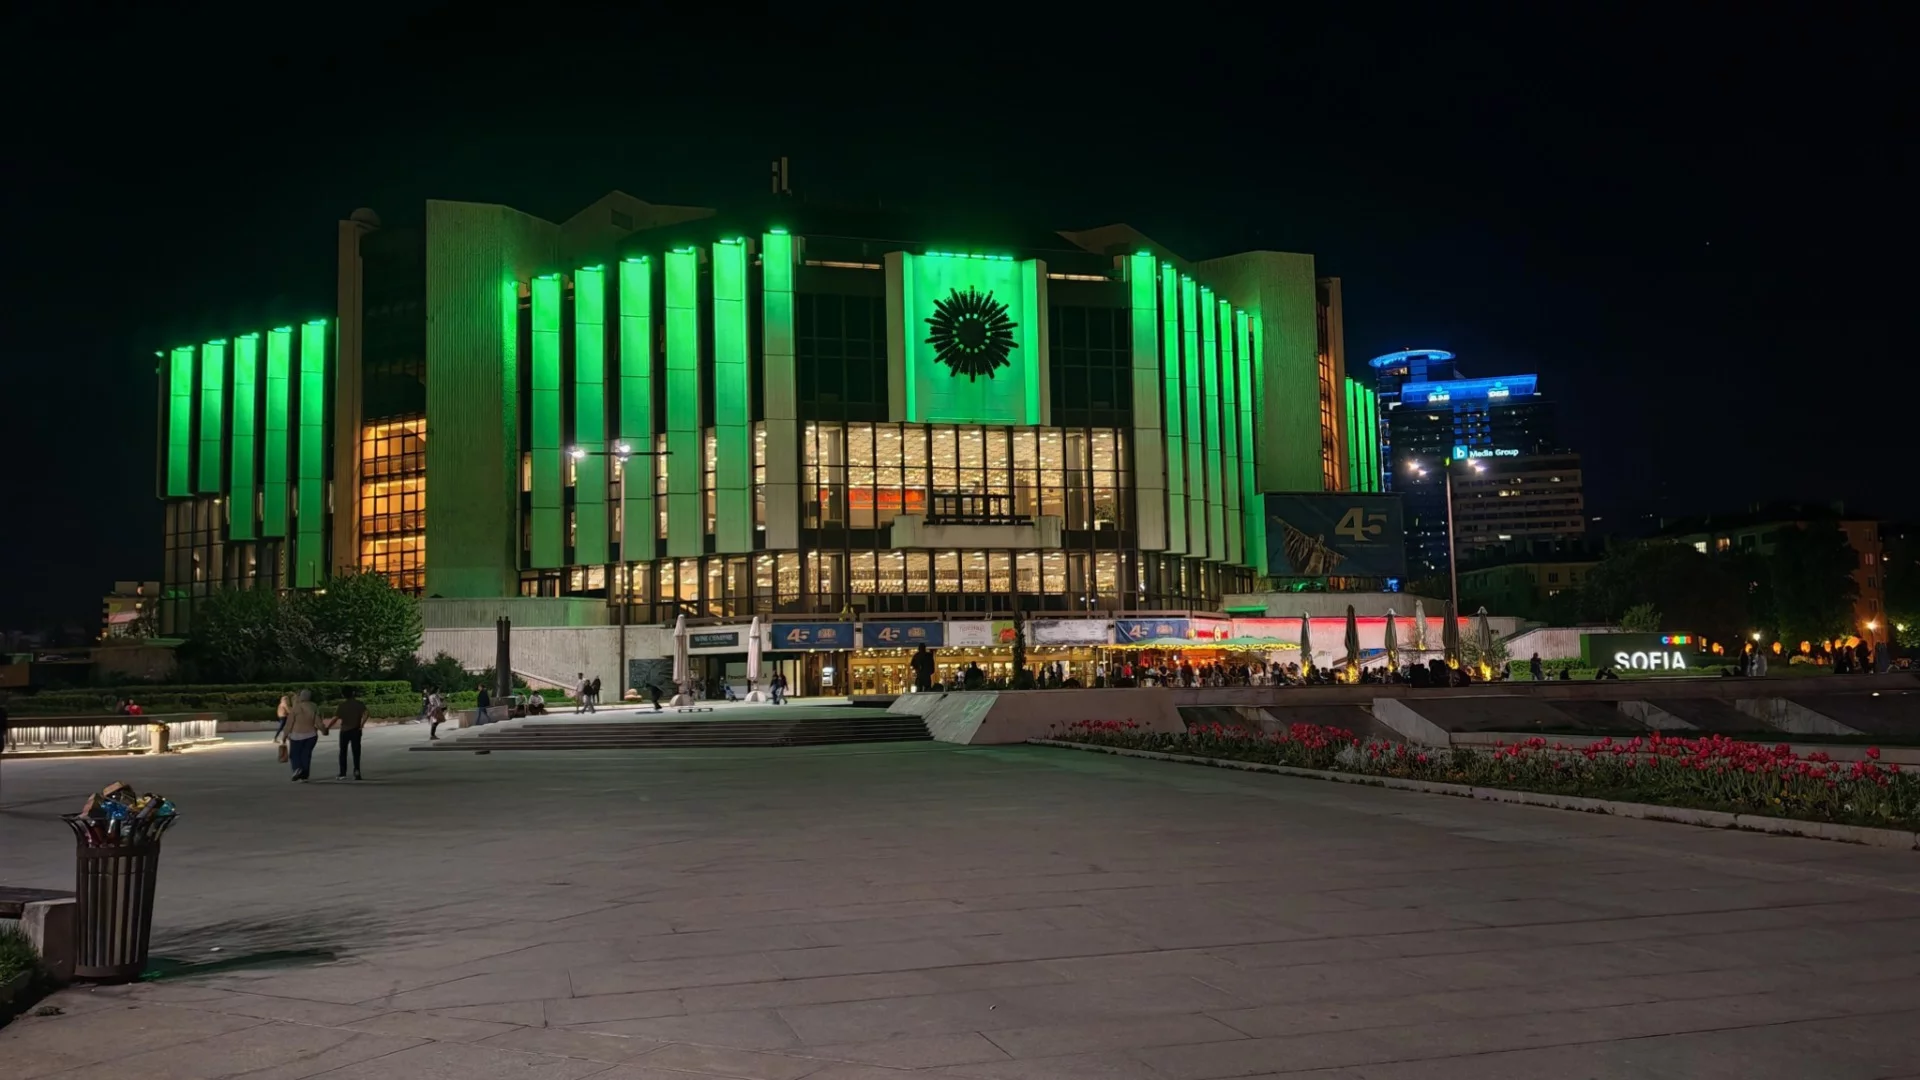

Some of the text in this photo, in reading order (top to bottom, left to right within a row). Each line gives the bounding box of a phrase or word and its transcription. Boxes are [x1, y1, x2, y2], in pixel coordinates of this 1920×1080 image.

[1469, 450, 1493, 458] Media
[1495, 449, 1519, 457] Group
[1334, 507, 1387, 542] 45
[787, 628, 811, 643] 45
[878, 627, 900, 642] 45
[1614, 651, 1687, 671] SOFIA
